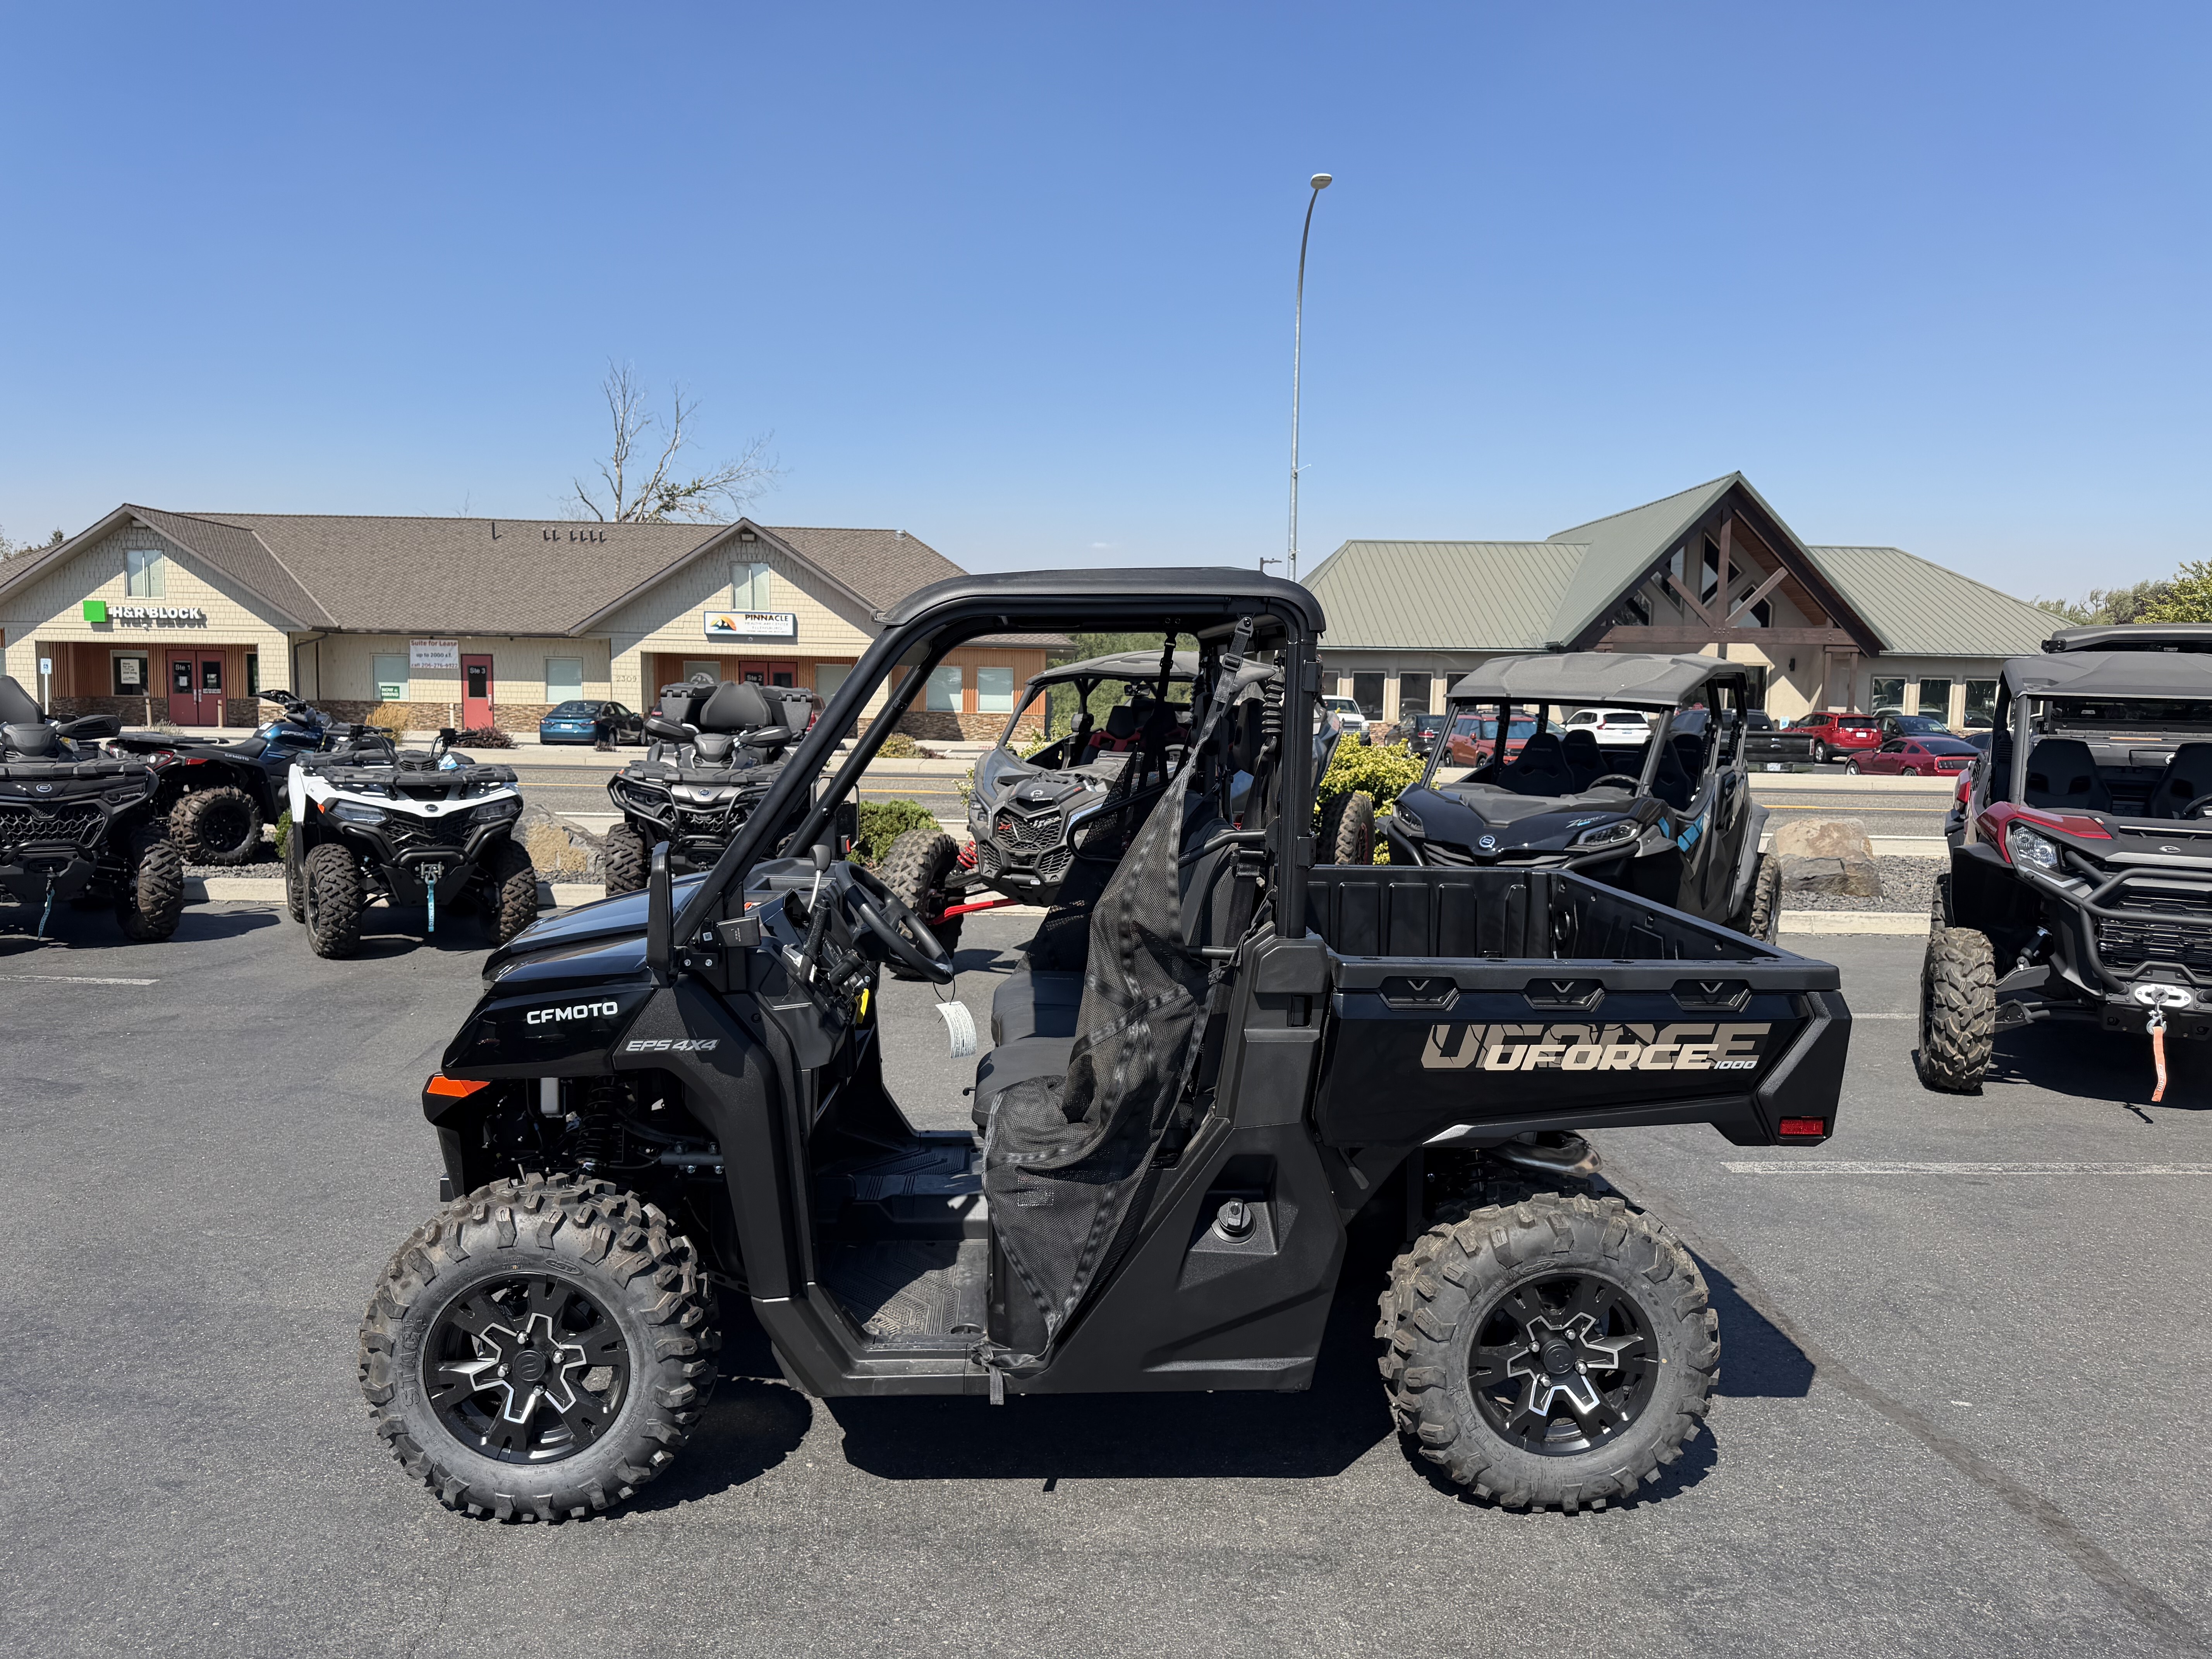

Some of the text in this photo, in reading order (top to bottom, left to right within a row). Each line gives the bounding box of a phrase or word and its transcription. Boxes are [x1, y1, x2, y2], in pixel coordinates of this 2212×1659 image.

[113, 606, 200, 619] H&R BLOCK
[527, 1001, 618, 1025] CFMOTO
[626, 1039, 719, 1051] EPS 4X4
[1484, 1044, 1757, 1070] UFORCE 1000
[400, 1331, 421, 1407] STAG
